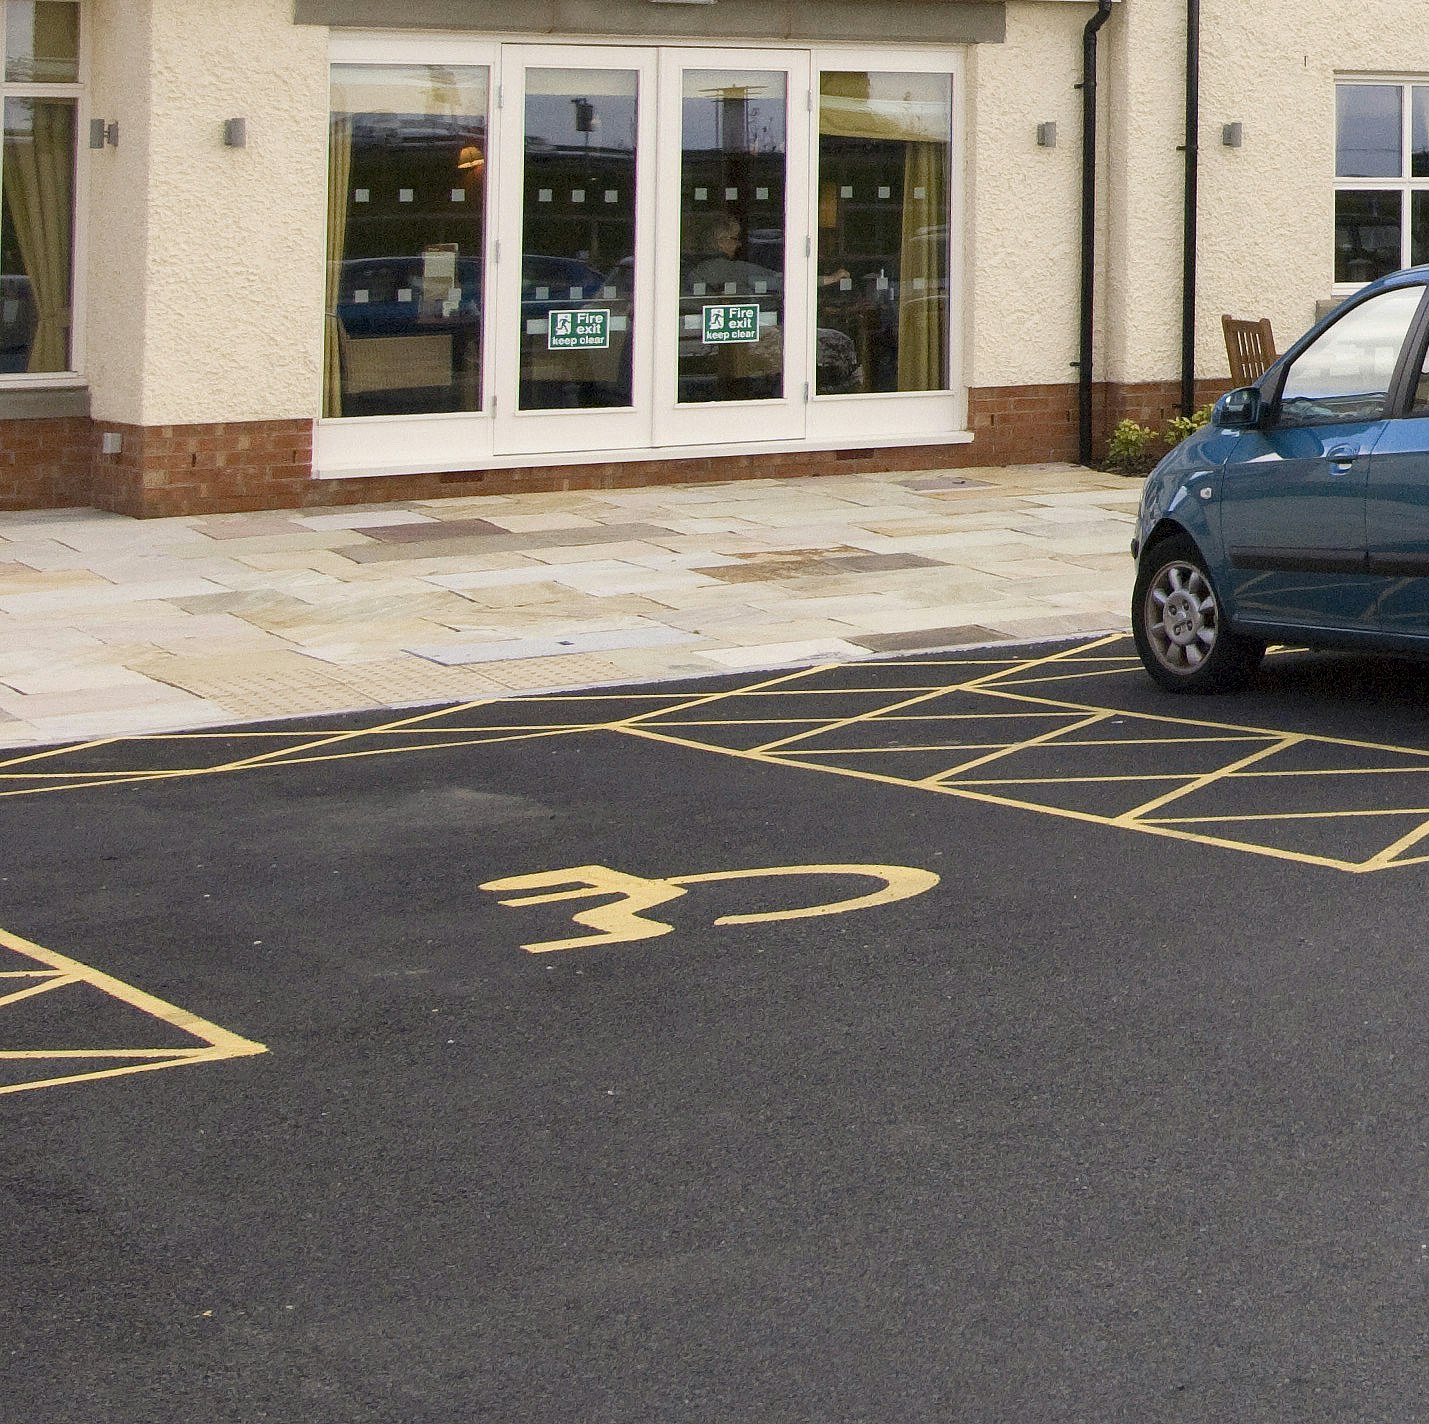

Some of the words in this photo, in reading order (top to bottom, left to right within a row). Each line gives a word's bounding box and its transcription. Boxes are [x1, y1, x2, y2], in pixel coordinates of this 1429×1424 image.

[577, 313, 604, 324] Fire
[729, 307, 754, 319] Fire
[576, 323, 602, 335] exit
[728, 317, 753, 329] exit
[552, 336, 578, 346] keep
[579, 335, 605, 345] clear
[706, 330, 730, 341] keep
[731, 329, 756, 339] clear
